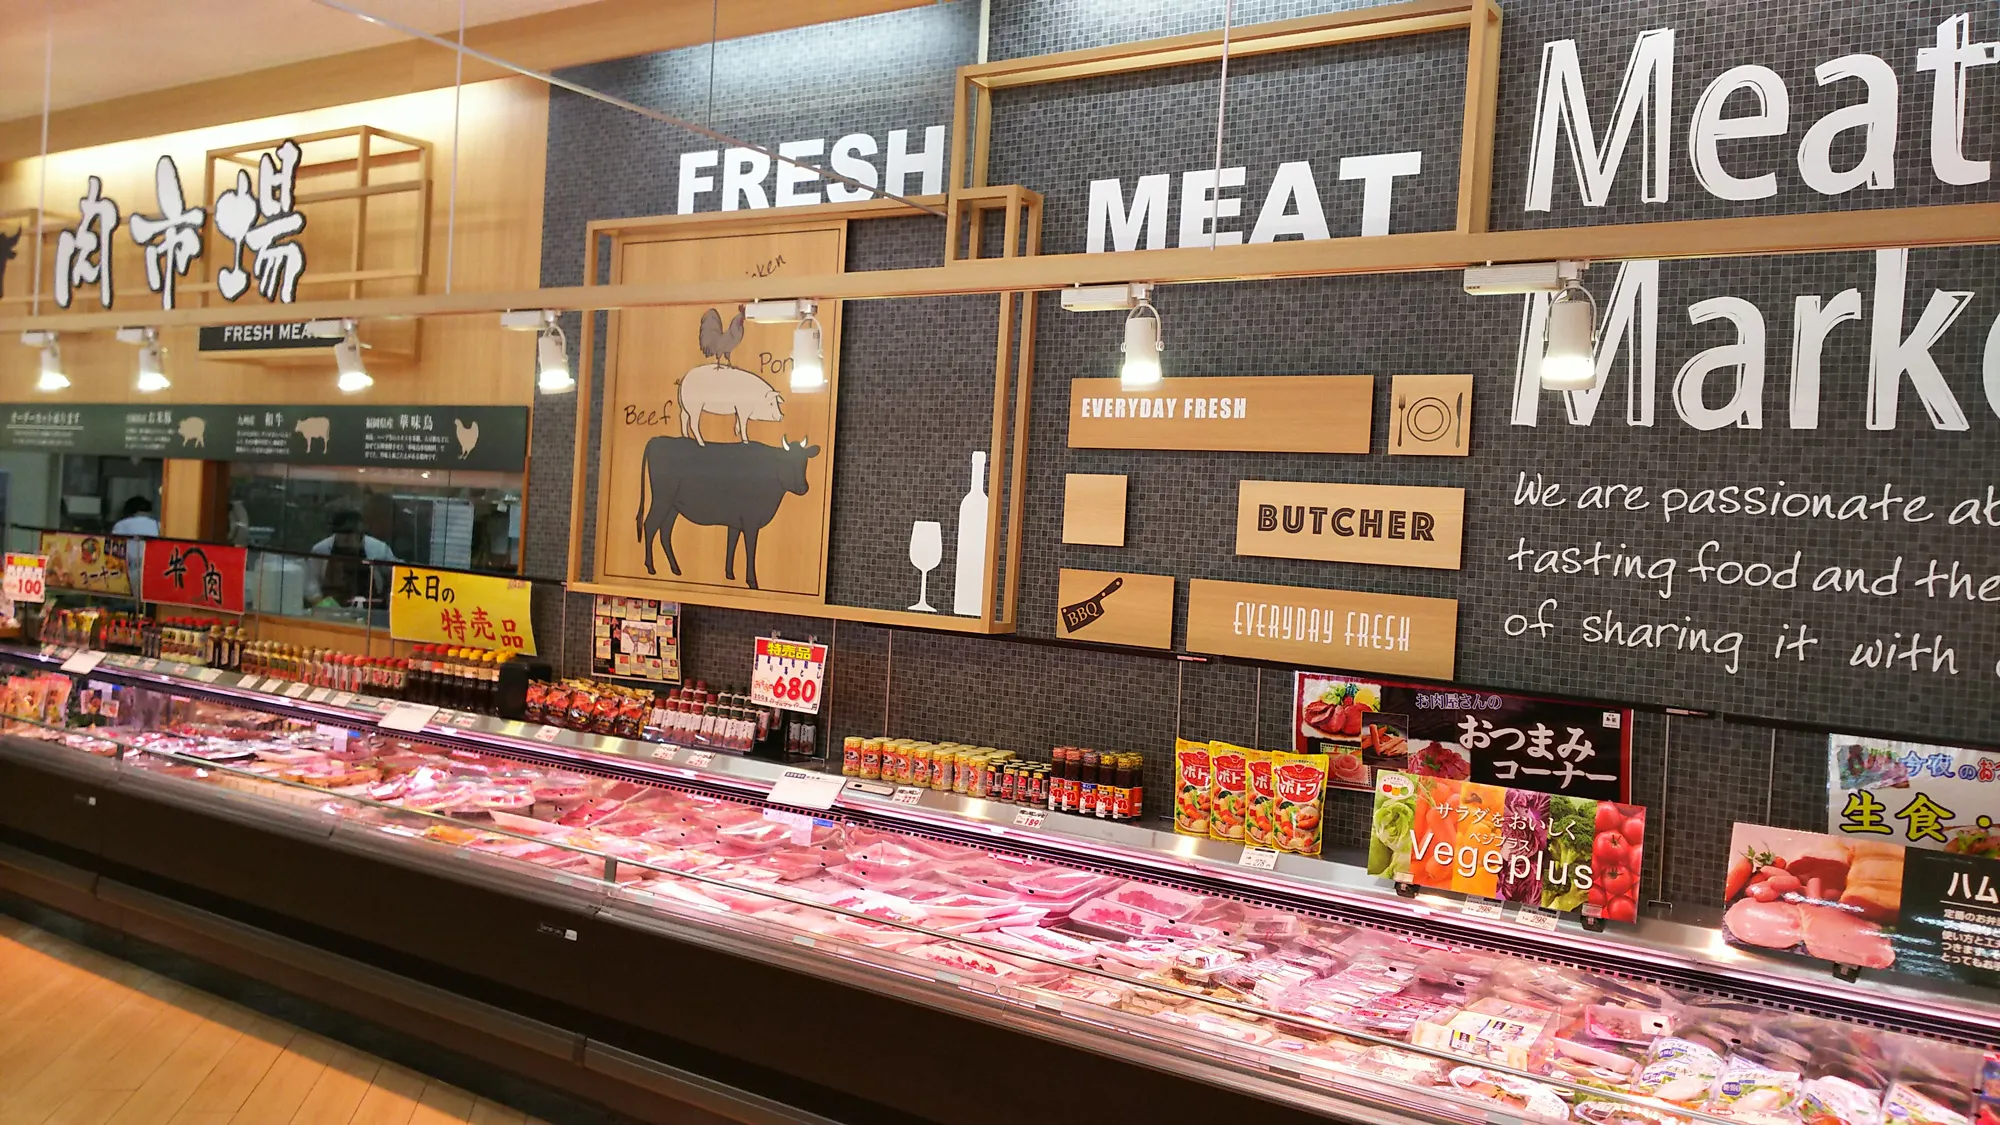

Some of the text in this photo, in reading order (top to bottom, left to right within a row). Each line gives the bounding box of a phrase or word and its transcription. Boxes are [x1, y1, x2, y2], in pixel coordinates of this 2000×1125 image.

[1524, 13, 2000, 212] Meat
[677, 125, 1421, 253] FRESH MEAT
[54, 138, 308, 311] 肉市場
[224, 322, 312, 342] FRESH MEA
[1511, 248, 2000, 431] Mark
[759, 352, 793, 374] Por
[624, 400, 673, 426] Beef
[1081, 397, 1247, 419] EVERYDAY FRESH
[1513, 471, 1566, 509] We
[1577, 482, 1650, 512] are
[1661, 480, 1934, 523] passionate
[1257, 504, 1435, 541] BUTCHER
[1507, 537, 1678, 599] tasting
[1688, 540, 1802, 591] food
[1812, 556, 1902, 597] and
[398, 569, 455, 604] 本日の
[440, 606, 524, 649] 特売品
[1067, 601, 1101, 628] BBQ
[1233, 601, 1411, 652] EVERYDAY FRESH
[767, 641, 812, 661] 特売品
[1504, 598, 1557, 639] of
[1582, 609, 1744, 674] sharing
[1774, 623, 1818, 662] it
[1849, 632, 1959, 675] with
[773, 676, 816, 703] 680
[1415, 692, 1503, 710] お肉屋さんの
[1457, 714, 1596, 762] おつまみ
[1493, 760, 1618, 790] コーナー
[1435, 803, 1577, 841] サラダをおいしく
[1409, 829, 1593, 890] Vegeplus
[1469, 832, 1531, 852] ベジプラス
[1947, 872, 1999, 904] ハム
[1530, 915, 1548, 924] 298
[1943, 908, 2000, 927] 定番のお弁
